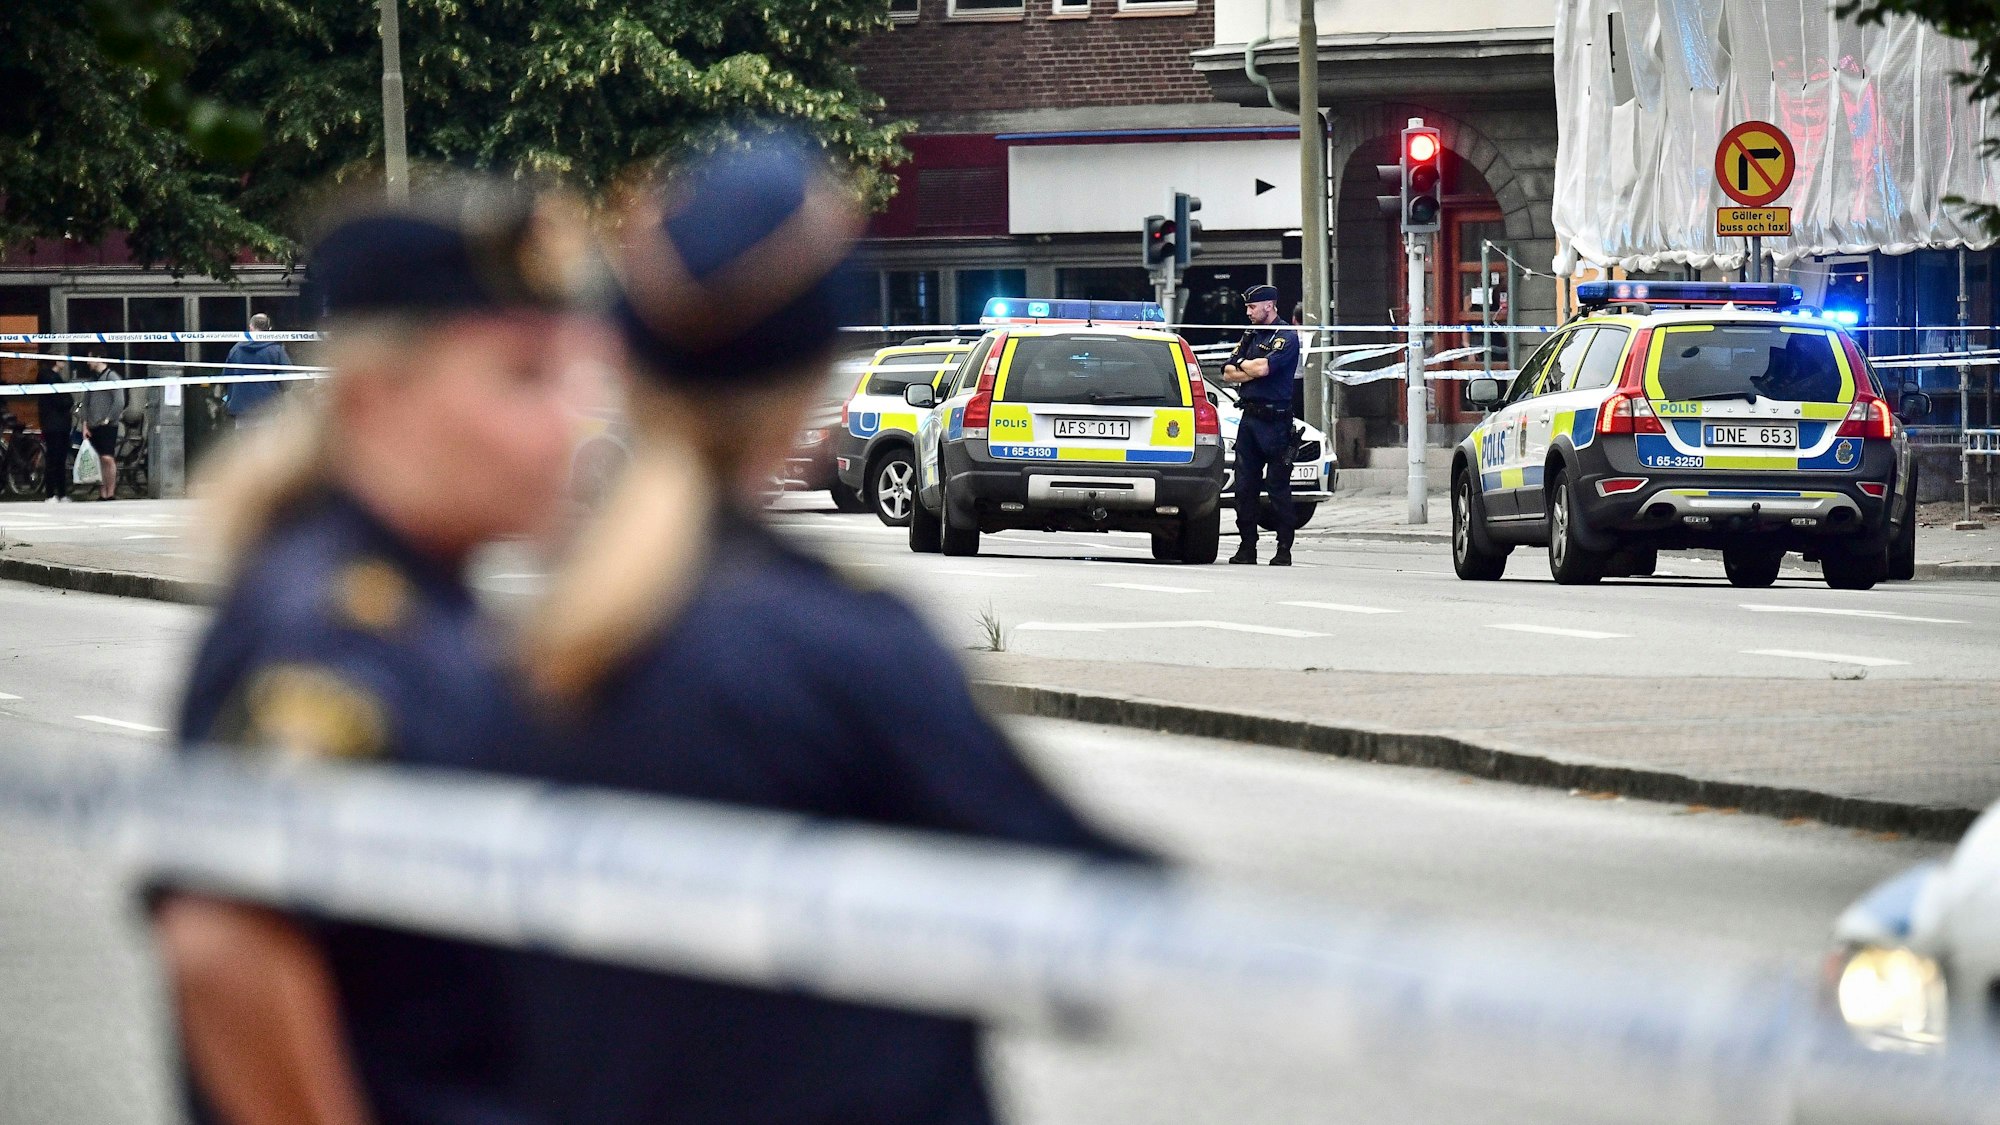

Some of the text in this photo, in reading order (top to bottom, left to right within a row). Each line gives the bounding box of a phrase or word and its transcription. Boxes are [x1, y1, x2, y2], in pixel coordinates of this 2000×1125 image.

[1732, 211, 1776, 222] Gäller ej
[1720, 222, 1787, 231] buss och taxi
[1660, 403, 1697, 413] POLIS
[995, 419, 1028, 428] POLIS
[1059, 420, 1125, 436] AFS 011
[1716, 427, 1747, 443] DNE
[1760, 428, 1792, 444] 653
[1003, 447, 1052, 458] 1 65-8130
[1481, 430, 1505, 469] POLIS
[1647, 456, 1702, 468] 1 65-3250
[1298, 468, 1314, 478] 107
